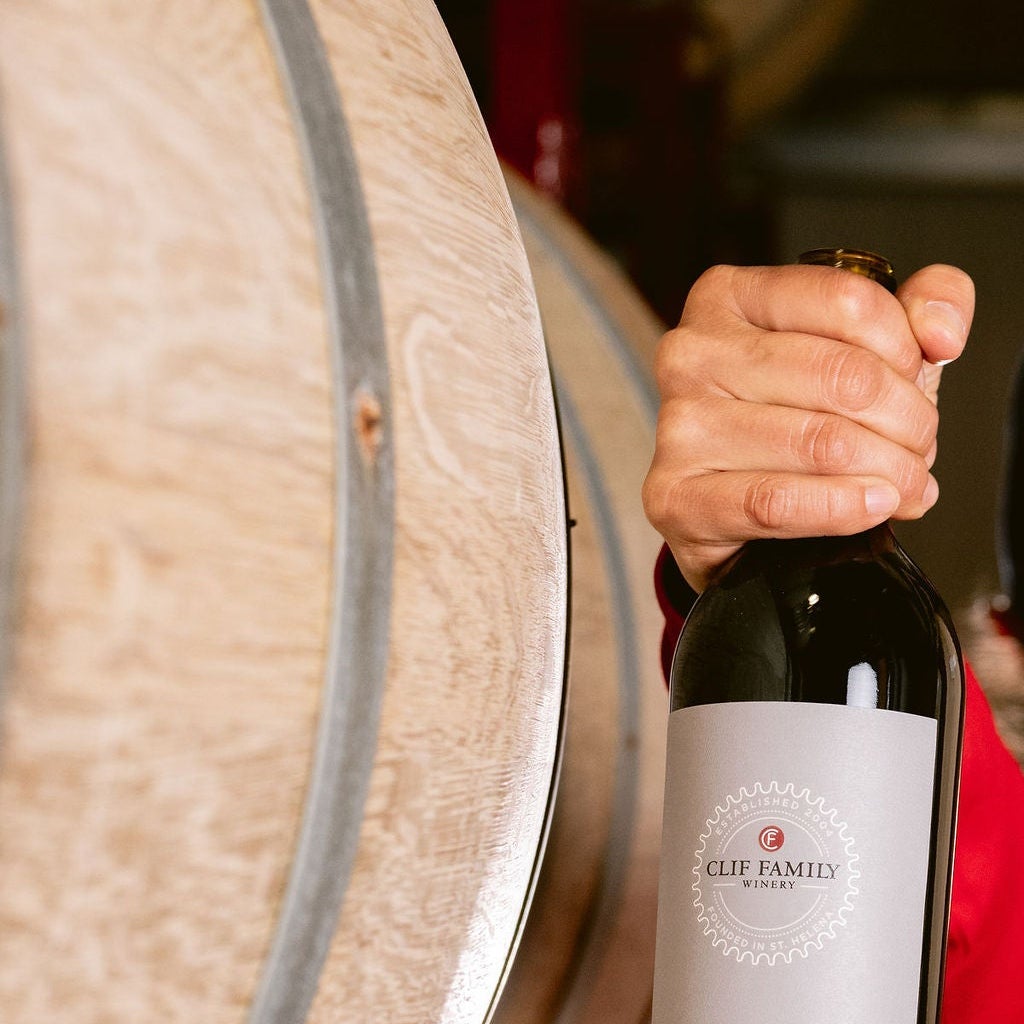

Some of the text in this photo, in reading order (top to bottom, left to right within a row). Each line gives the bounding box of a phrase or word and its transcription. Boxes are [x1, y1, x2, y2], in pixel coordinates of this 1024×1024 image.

[714, 796, 800, 836] ESTABLISHED
[706, 860, 841, 880] CLIF FAMILY
[742, 879, 796, 889] WINERY
[707, 906, 834, 951] FOUNDED IN ST. HELENA
